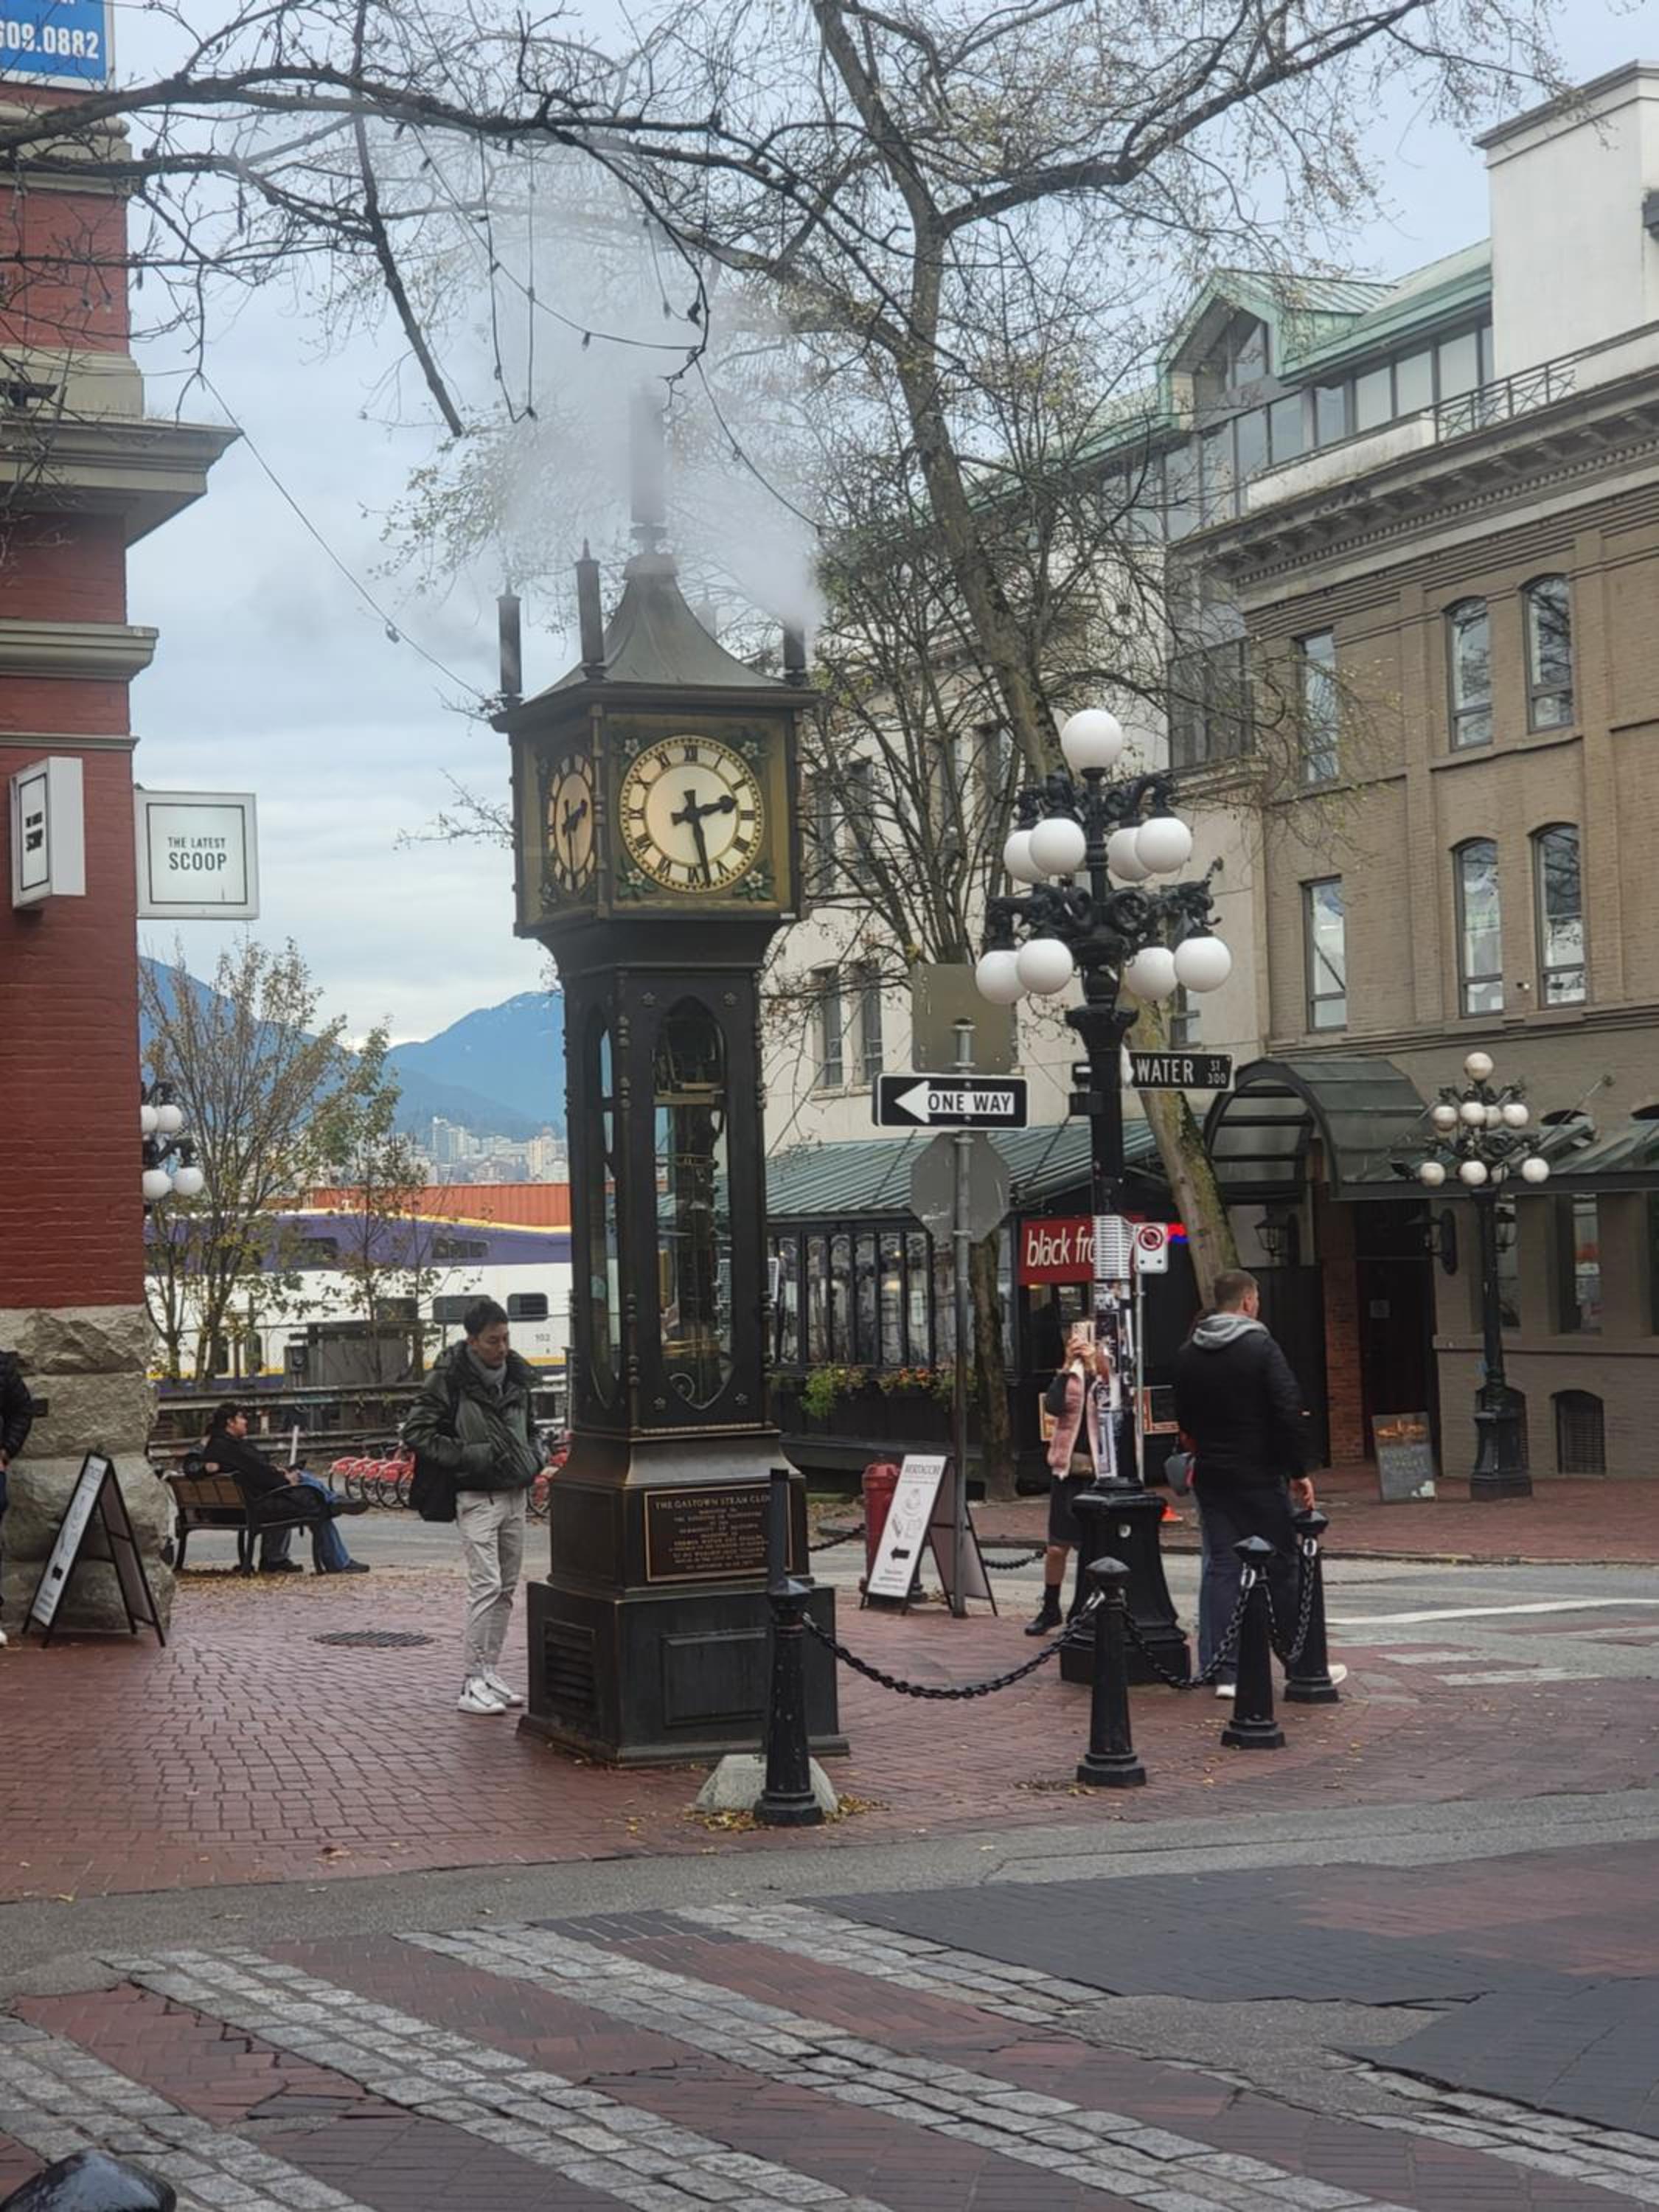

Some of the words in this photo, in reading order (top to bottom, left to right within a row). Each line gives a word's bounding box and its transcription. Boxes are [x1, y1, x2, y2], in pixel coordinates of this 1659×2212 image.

[167, 836, 186, 848] THE
[191, 837, 226, 849] LATEST
[169, 852, 226, 871] SCOOP
[1136, 1058, 1194, 1083] WATER
[928, 1093, 964, 1111] ONE
[973, 1093, 1011, 1112] WAY
[1026, 1226, 1071, 1267] black
